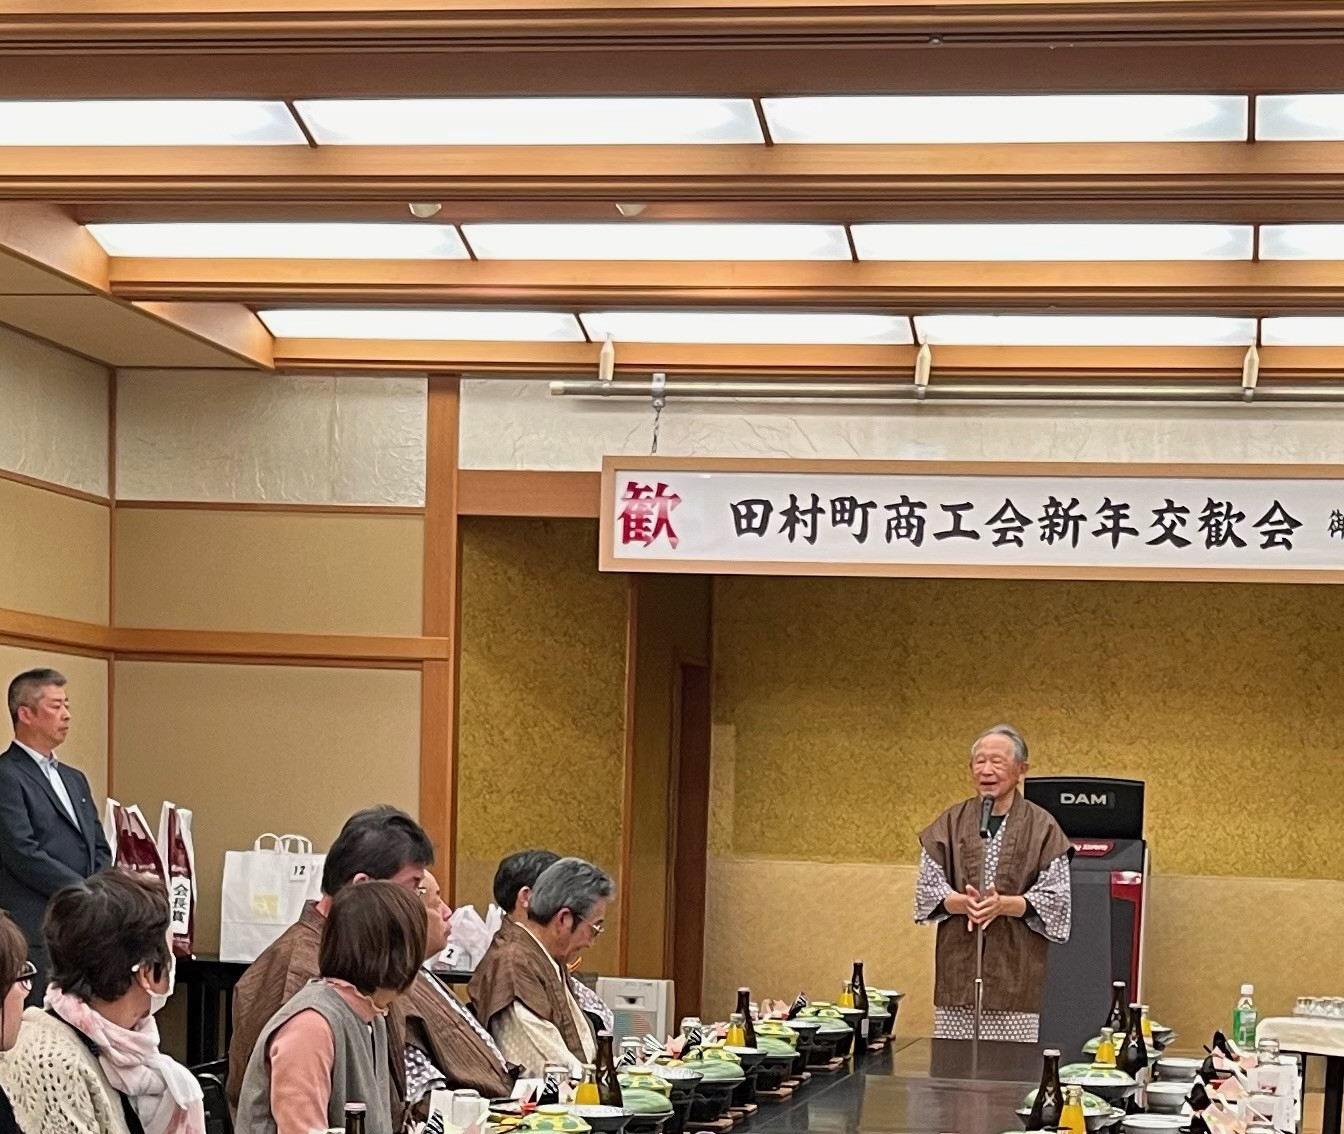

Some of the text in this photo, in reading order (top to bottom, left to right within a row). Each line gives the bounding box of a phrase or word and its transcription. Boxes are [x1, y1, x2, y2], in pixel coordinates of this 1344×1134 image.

[616, 481, 682, 550] 歓
[729, 493, 1303, 552] 田村町商工会新年交歓会
[1060, 792, 1107, 805] DAM
[293, 865, 306, 876] 12
[446, 948, 455, 959] 2
